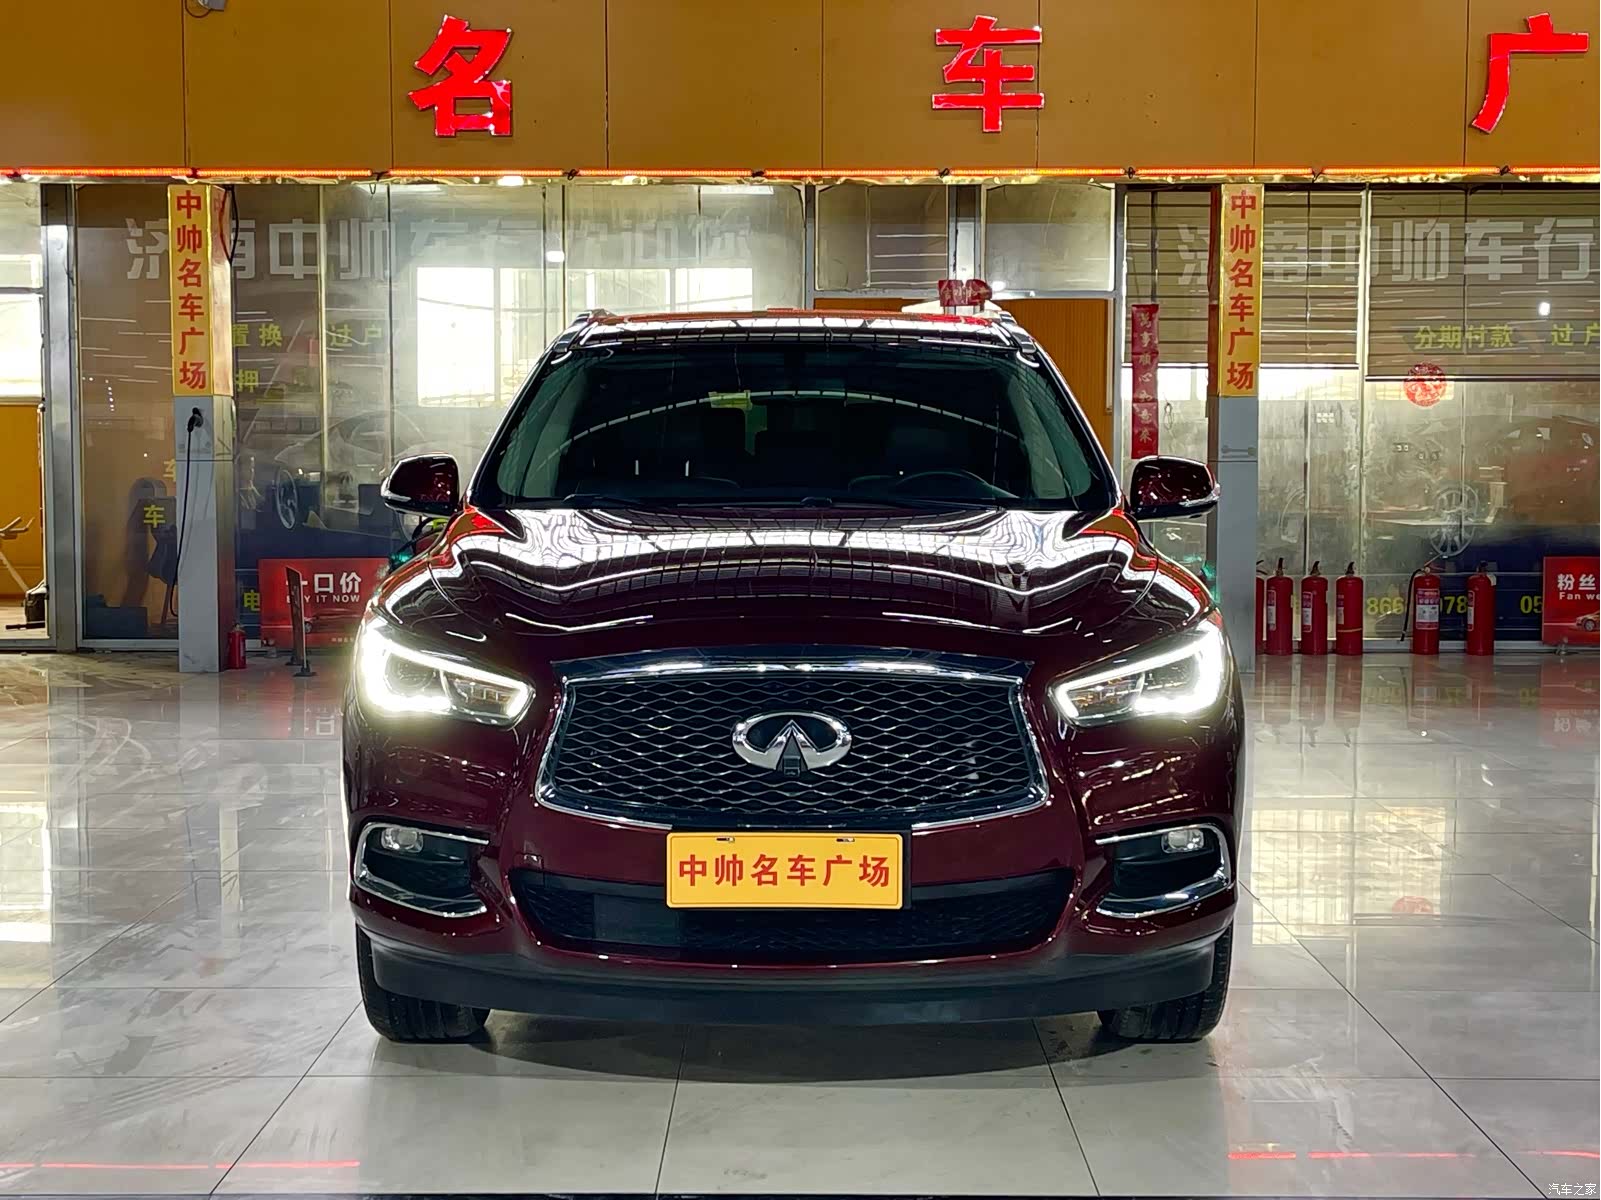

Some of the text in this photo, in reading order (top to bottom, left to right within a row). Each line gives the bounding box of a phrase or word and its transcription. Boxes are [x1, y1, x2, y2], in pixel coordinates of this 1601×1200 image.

[408, 12, 1589, 136] 名 车 广
[176, 190, 207, 389] 中帅名车广场
[1227, 189, 1257, 390] 中帅名车广场
[232, 323, 282, 347] 置换
[1415, 325, 1514, 349] 分期付款
[236, 369, 259, 393] 押
[143, 504, 166, 528] 车
[1557, 573, 1597, 591] 粉丝
[243, 589, 260, 612] 电
[316, 594, 328, 603] IT
[333, 594, 360, 602] NOW
[1559, 591, 1581, 600] Fan
[678, 853, 890, 887] 中帅名车广场
